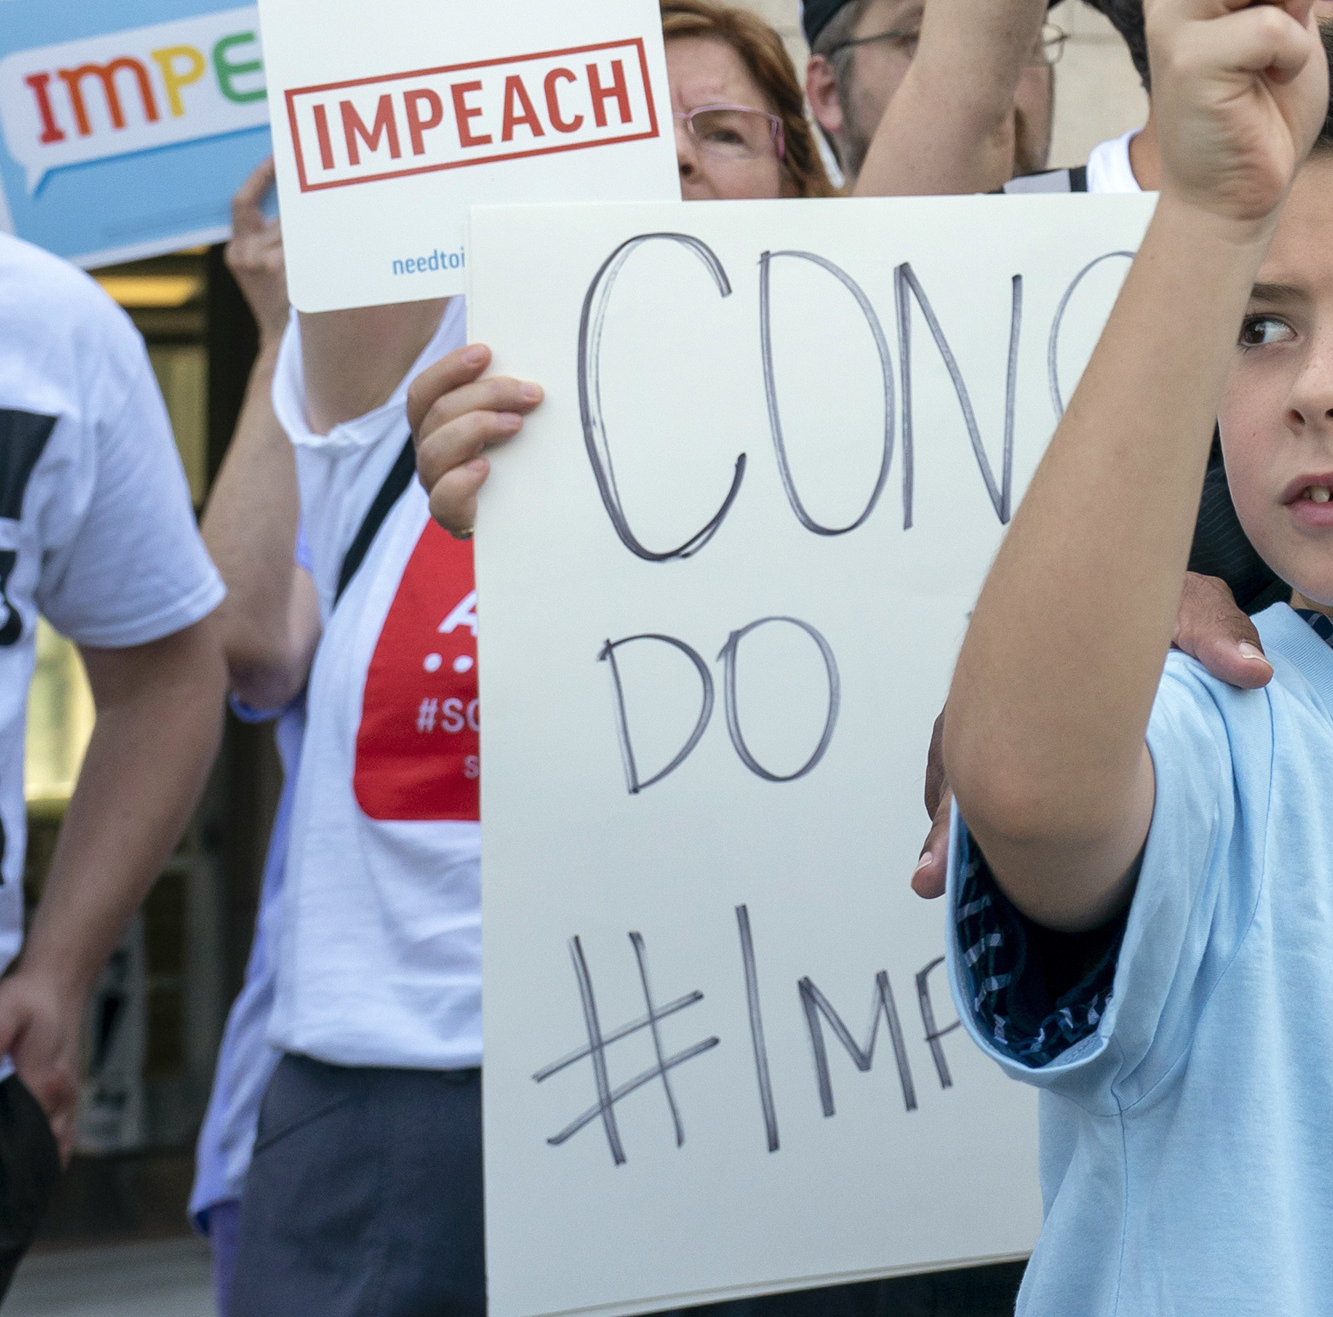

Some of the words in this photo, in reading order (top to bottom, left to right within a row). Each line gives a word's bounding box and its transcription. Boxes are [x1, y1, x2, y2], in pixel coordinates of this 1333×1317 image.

[311, 59, 635, 172] IMPEACH
[391, 246, 466, 277] needtoi
[597, 614, 841, 795] DO
